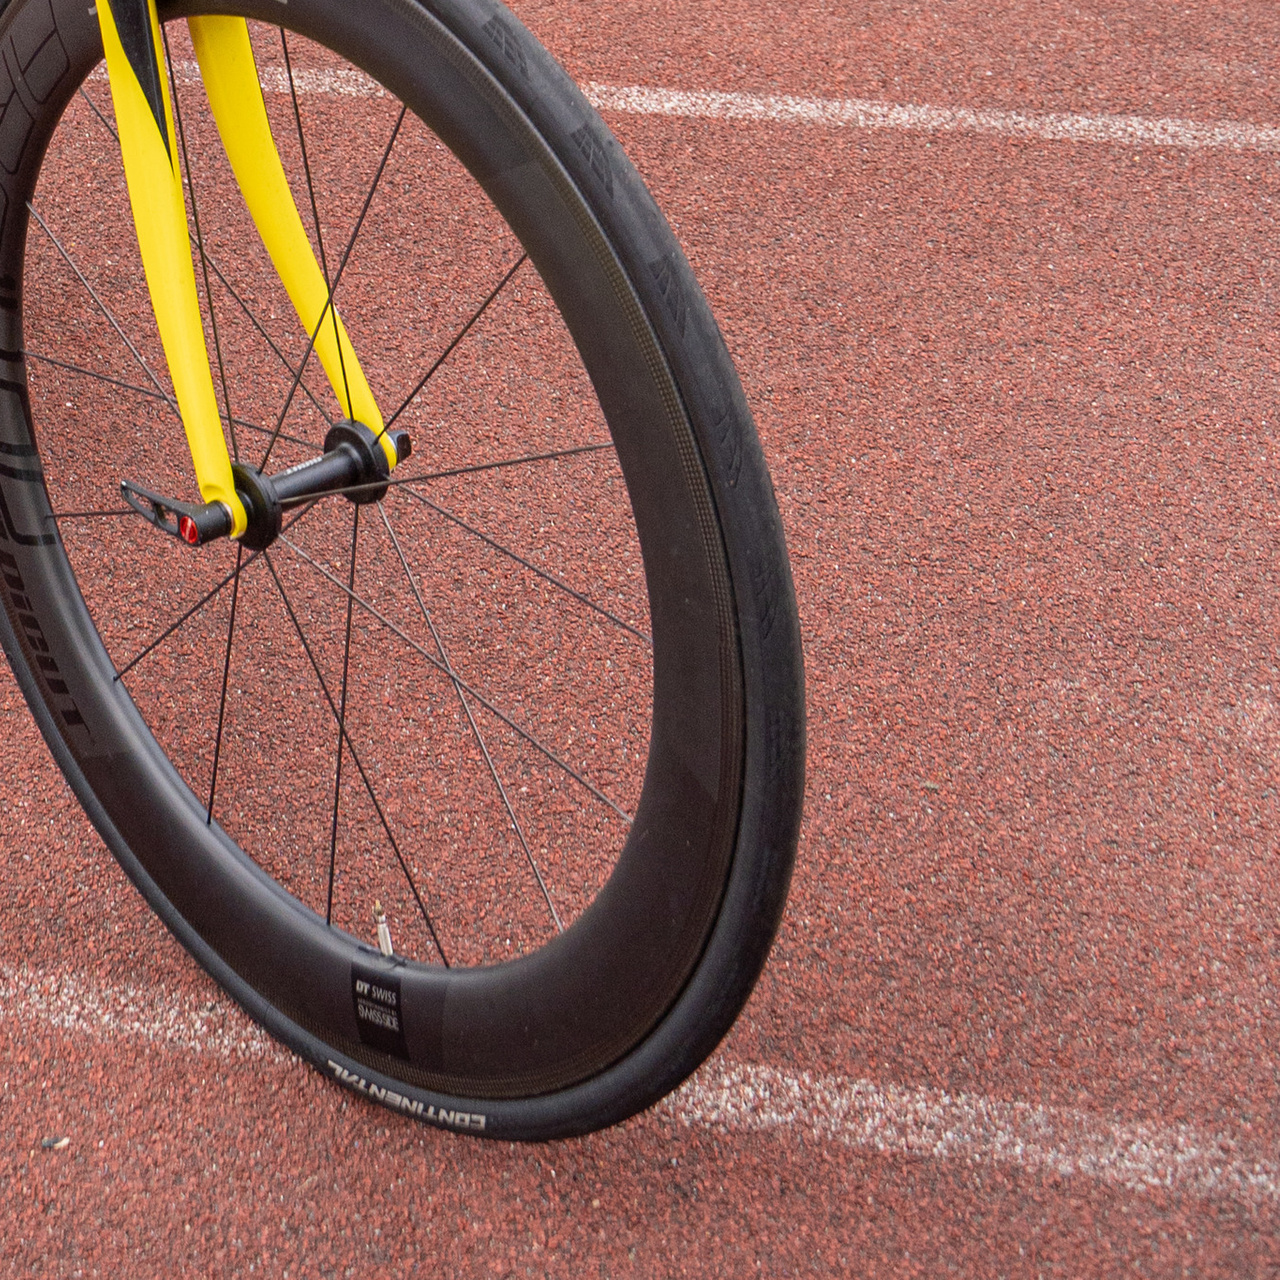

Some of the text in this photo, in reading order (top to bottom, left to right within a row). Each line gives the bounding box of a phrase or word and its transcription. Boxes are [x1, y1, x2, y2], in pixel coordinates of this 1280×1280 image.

[356, 979, 397, 1006] DT SWISS
[327, 1059, 487, 1131] CONTINENTAL
